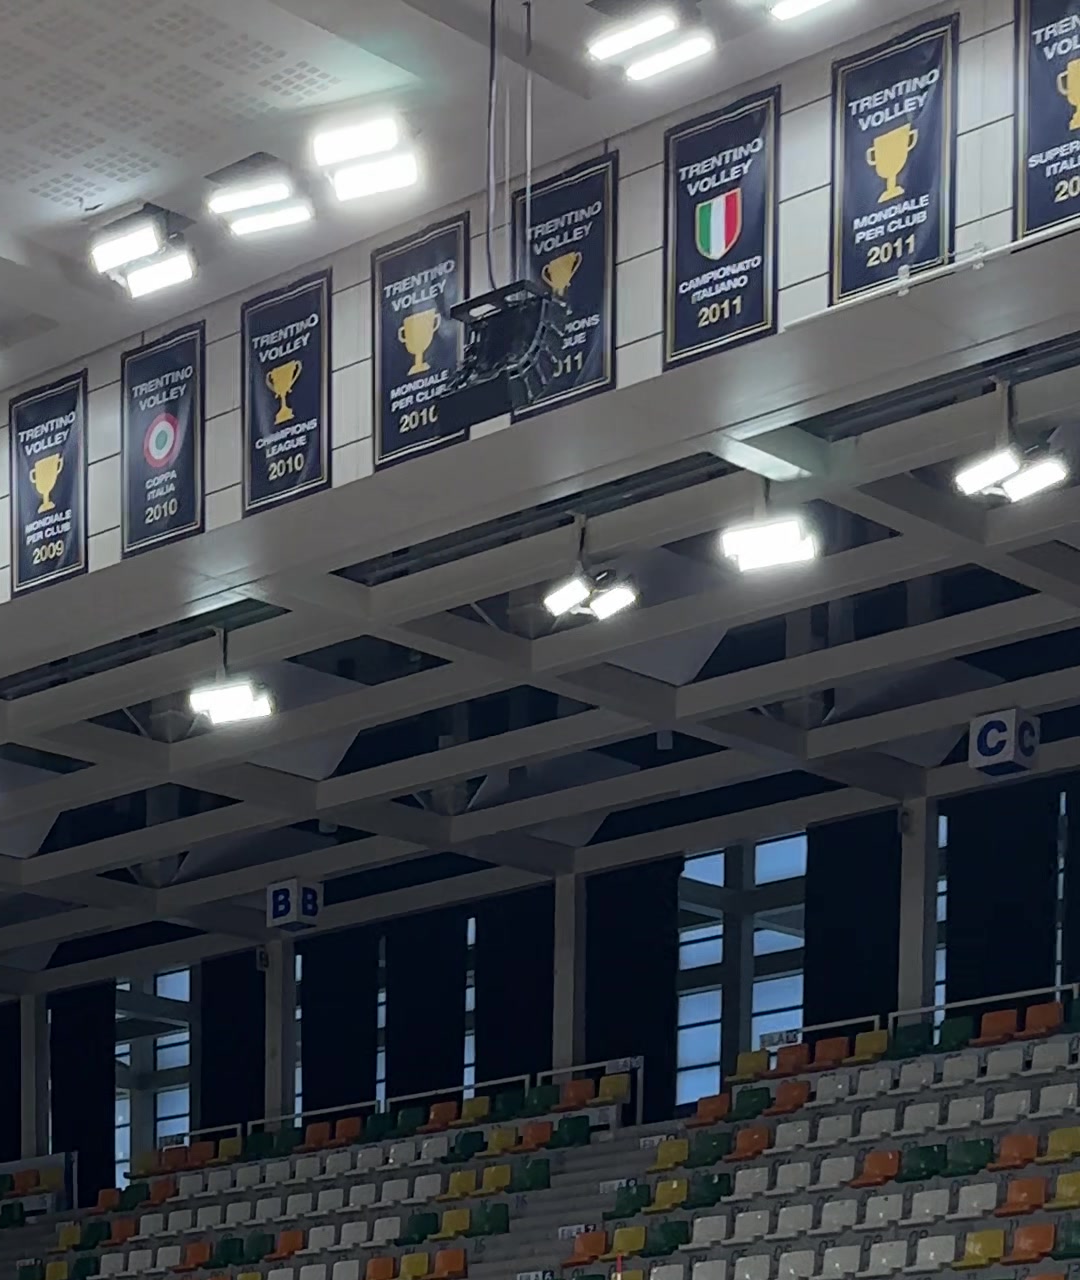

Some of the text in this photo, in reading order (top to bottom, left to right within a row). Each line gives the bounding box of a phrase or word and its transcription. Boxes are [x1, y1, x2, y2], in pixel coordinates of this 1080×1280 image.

[848, 67, 940, 116] TRENTINO
[858, 91, 929, 131] VOLLEY
[679, 138, 763, 182] TRENTINO
[687, 159, 754, 197] VOLLEY
[528, 200, 602, 241] TRENTINO
[853, 195, 929, 231] MONDIALE
[855, 210, 928, 244] PER CLUB
[534, 222, 593, 255] VOLLEY
[866, 234, 916, 267] 2011
[384, 260, 455, 299] TRENTINO
[679, 255, 762, 295] CAMPIONATO
[691, 275, 748, 304] ITALIANO
[391, 279, 447, 311] VOLLEY
[698, 296, 742, 328] 2011
[252, 313, 319, 350] TRENTINO
[259, 333, 311, 363] VOLLEY
[132, 365, 193, 399] TRENTINO
[139, 384, 186, 411] VOLLEY
[390, 370, 449, 400] MONDIALE
[391, 394, 414, 412] PER
[18, 411, 76, 444] TRENTINO
[25, 429, 70, 456] VOLLEY
[265, 435, 307, 458] LEAGUE
[145, 470, 177, 490] COPPA
[268, 453, 304, 480] 2010
[144, 498, 178, 525] 2010
[32, 540, 65, 565] 2009
[977, 720, 1007, 757] C
[273, 888, 291, 919] B
[302, 887, 318, 916] B
